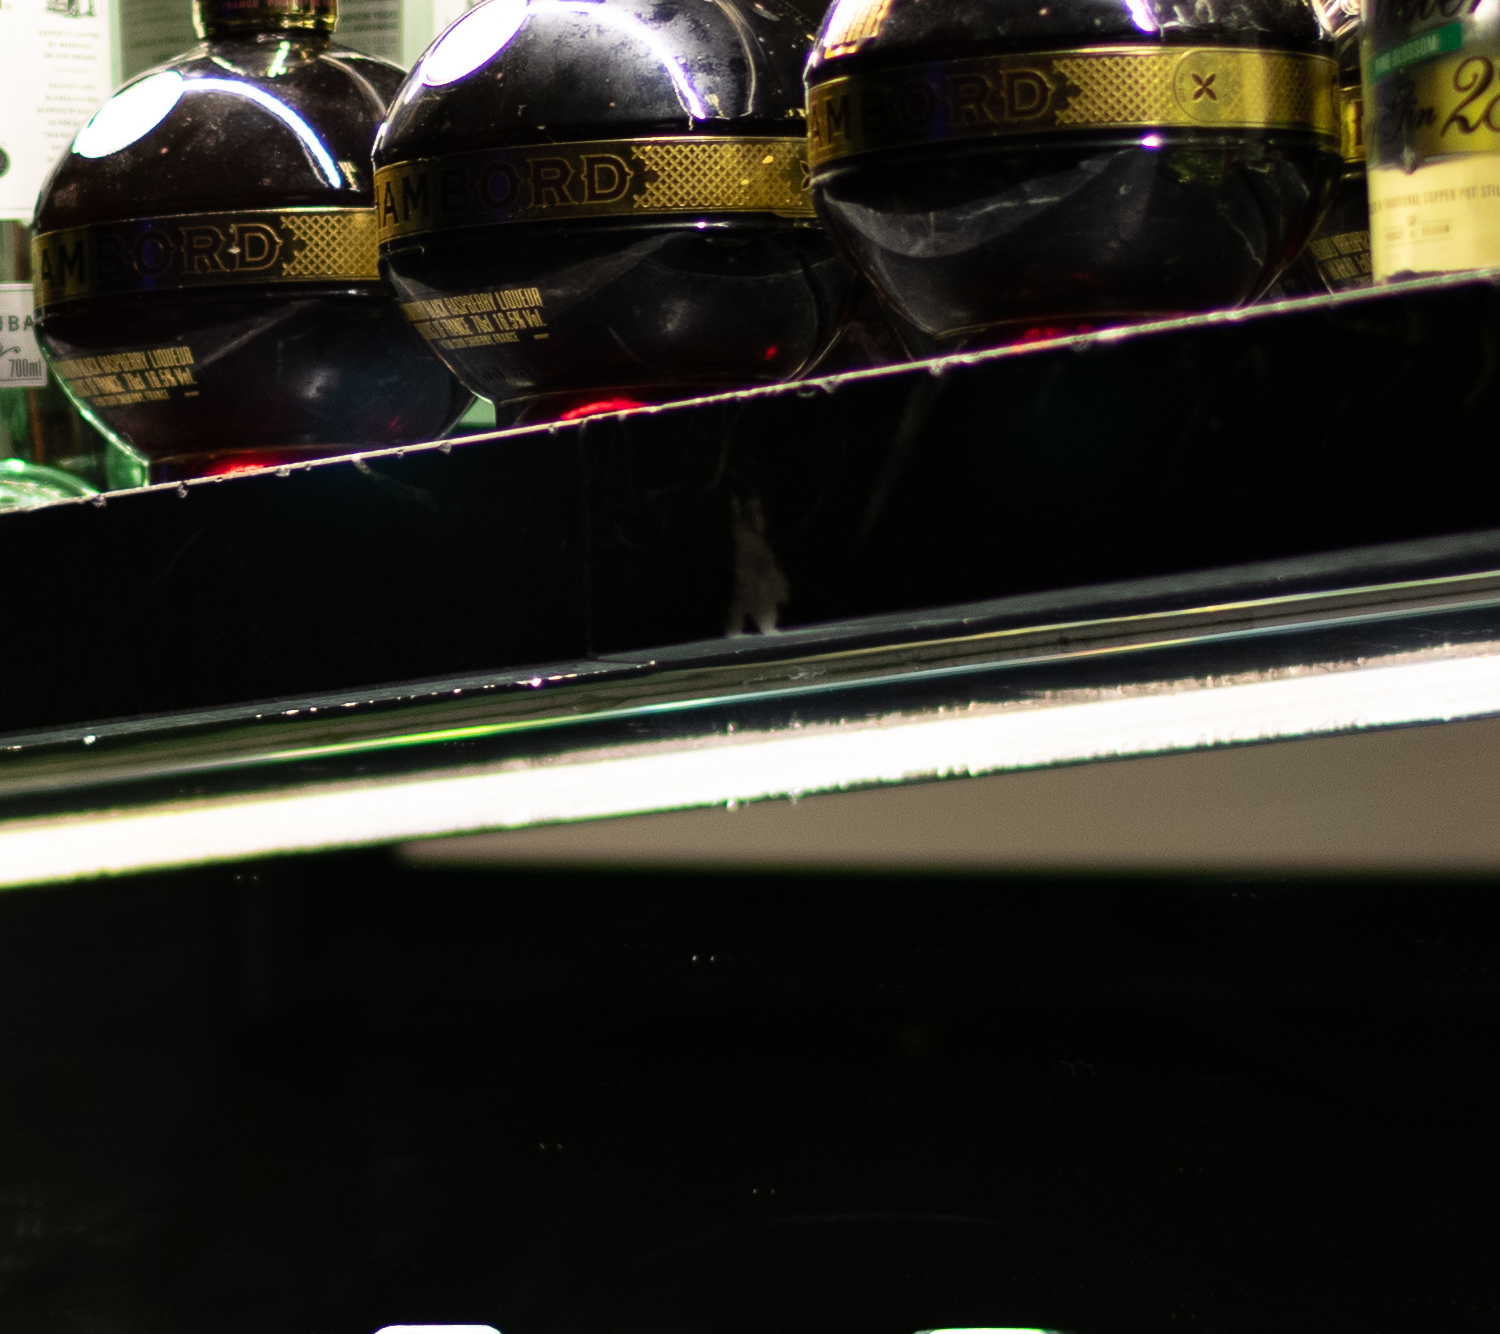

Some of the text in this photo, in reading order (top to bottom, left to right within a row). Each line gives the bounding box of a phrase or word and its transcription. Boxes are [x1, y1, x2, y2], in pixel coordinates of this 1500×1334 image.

[495, 288, 543, 310] LIQUEUR
[8, 357, 42, 378] 700ml
[149, 347, 194, 367] LIQUEUR
